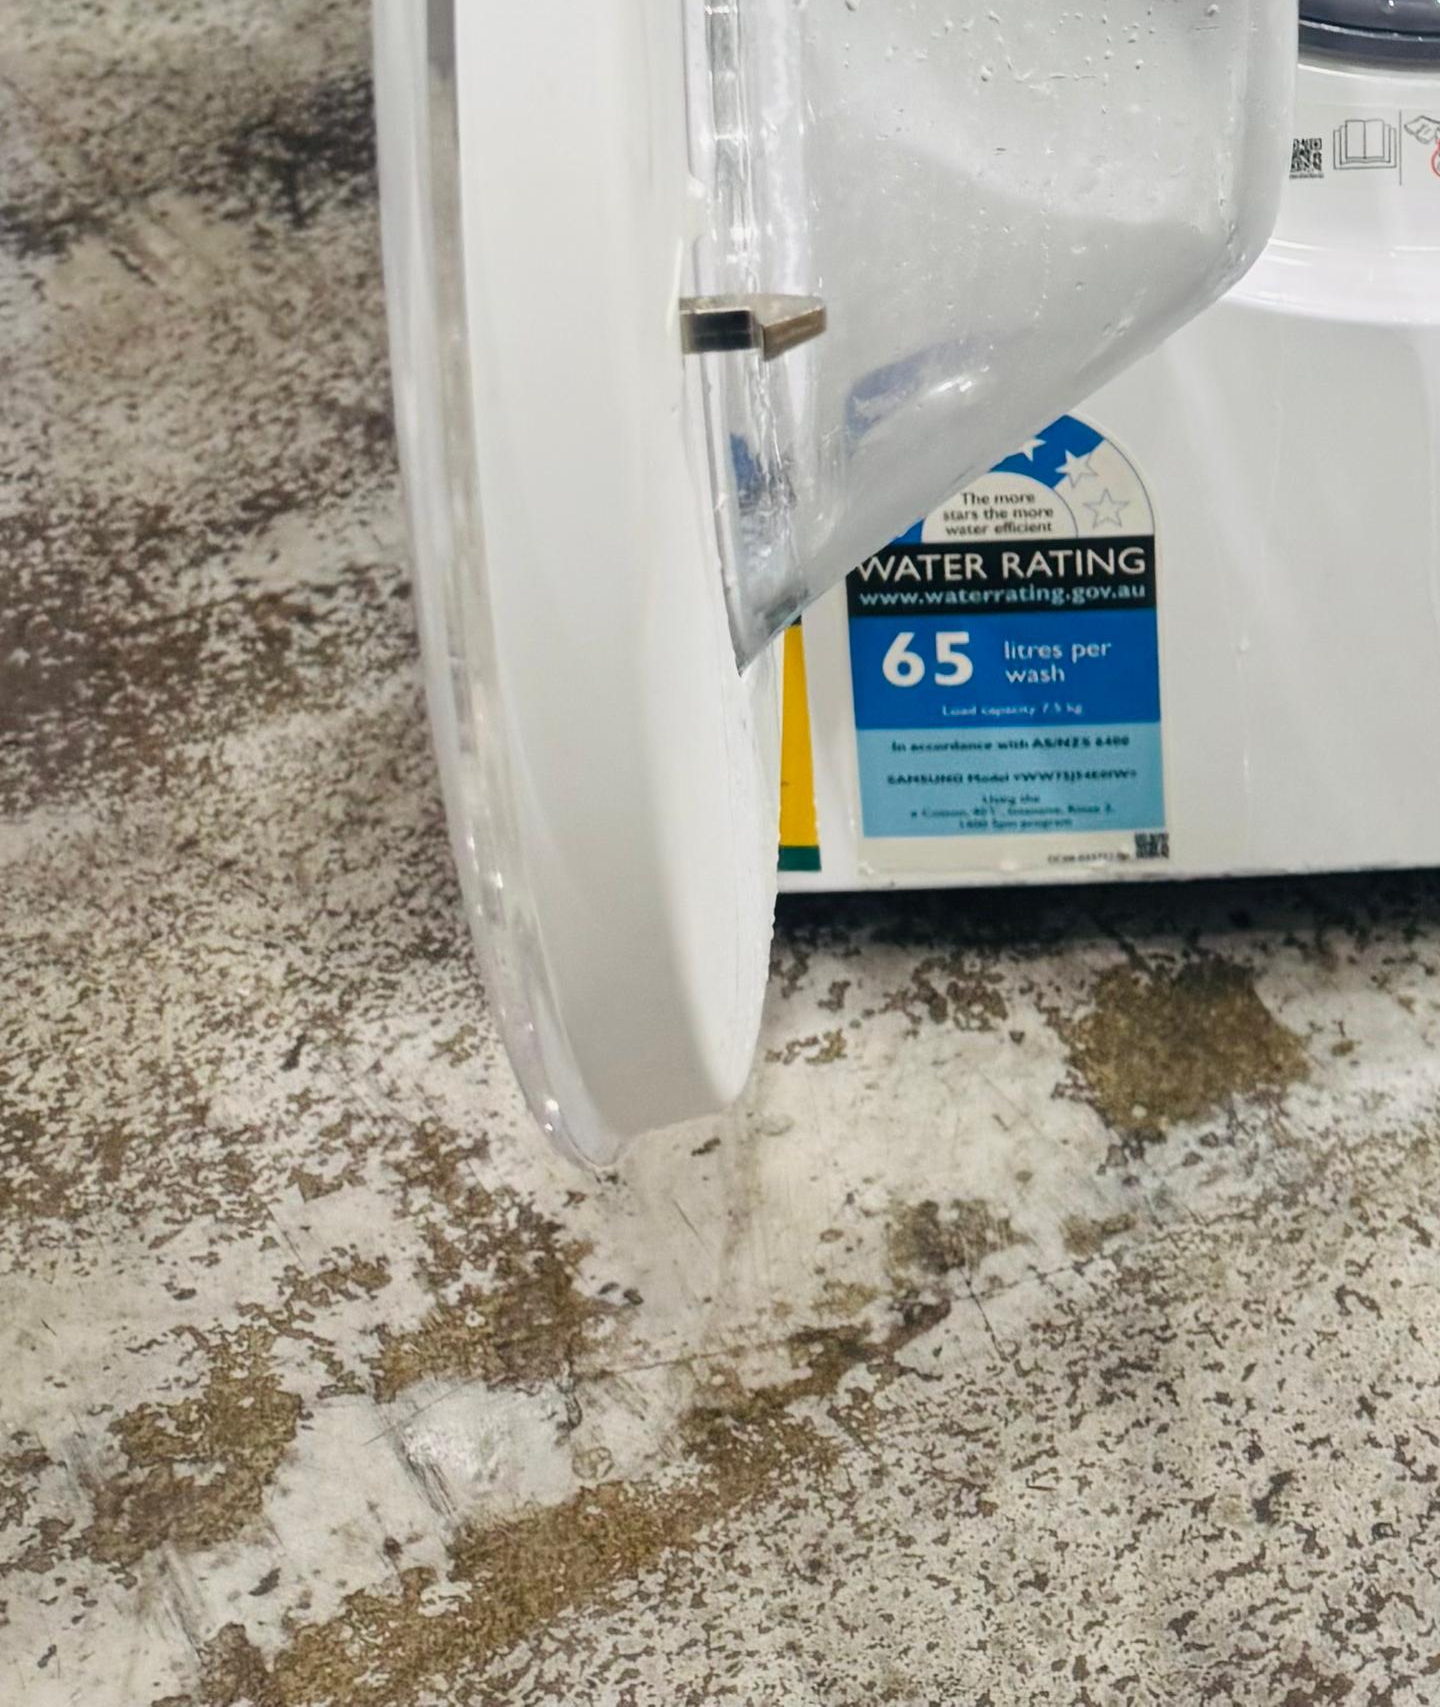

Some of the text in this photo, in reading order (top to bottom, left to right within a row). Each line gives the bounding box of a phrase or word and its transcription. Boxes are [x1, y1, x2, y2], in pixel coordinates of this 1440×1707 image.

[961, 492, 1035, 505] The more
[943, 507, 1053, 521] stars the more
[945, 522, 1053, 536] water efficient
[856, 547, 1147, 583] WATER RATING
[859, 584, 1147, 606] www.waterrating.gov.au
[881, 630, 974, 687] 65
[1004, 640, 1113, 664] litres per
[1005, 664, 1066, 684] wash
[998, 738, 1030, 750] with
